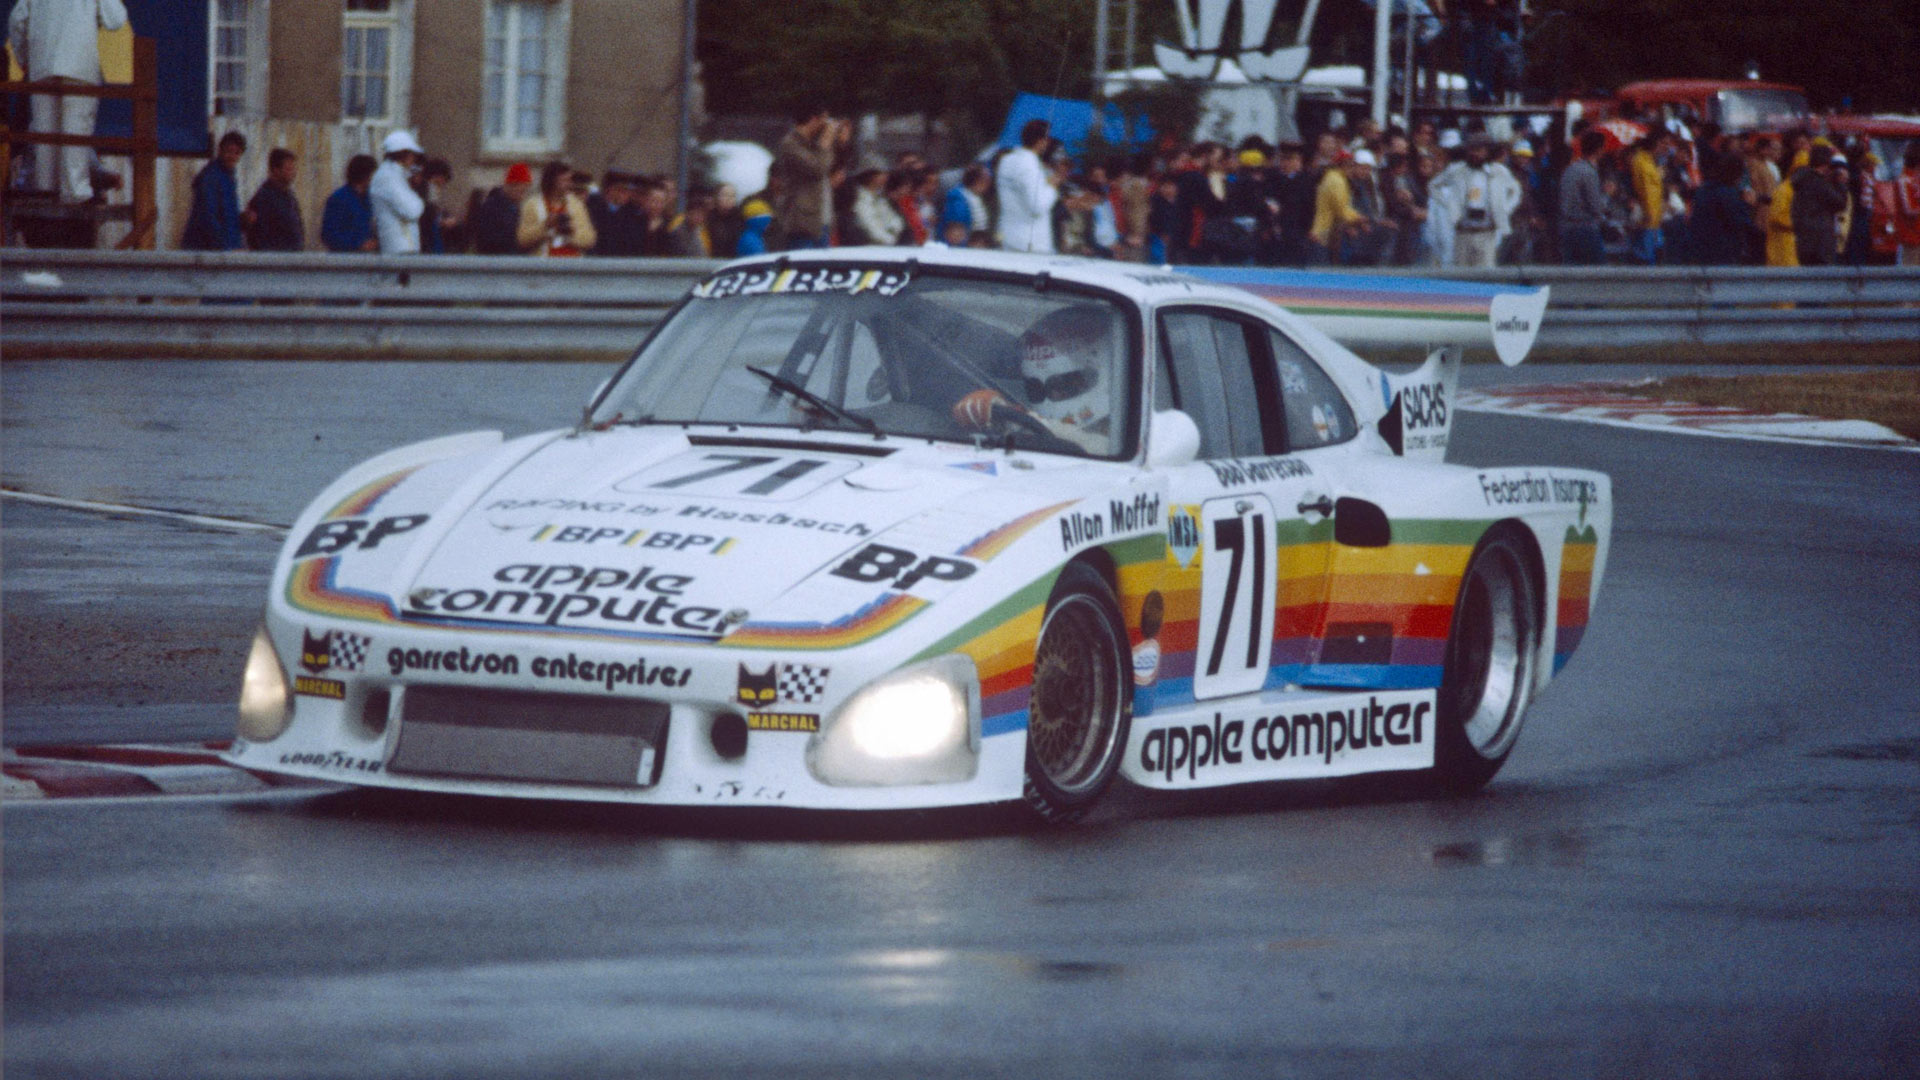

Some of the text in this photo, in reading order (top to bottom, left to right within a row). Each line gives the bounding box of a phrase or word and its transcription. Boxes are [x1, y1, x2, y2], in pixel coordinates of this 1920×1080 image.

[1403, 382, 1447, 430] SACHS
[649, 453, 828, 496] 71
[292, 514, 431, 559] BP
[553, 525, 715, 552] BP BP
[1060, 491, 1160, 553] Allan Moffat
[1168, 515, 1199, 548] IMSA
[493, 564, 695, 593] apple
[829, 543, 978, 591] BP
[1205, 513, 1266, 677] 71
[387, 646, 692, 692] garretson enterprises
[749, 714, 817, 731] MARCHAL
[1140, 696, 1431, 783] apple computer
